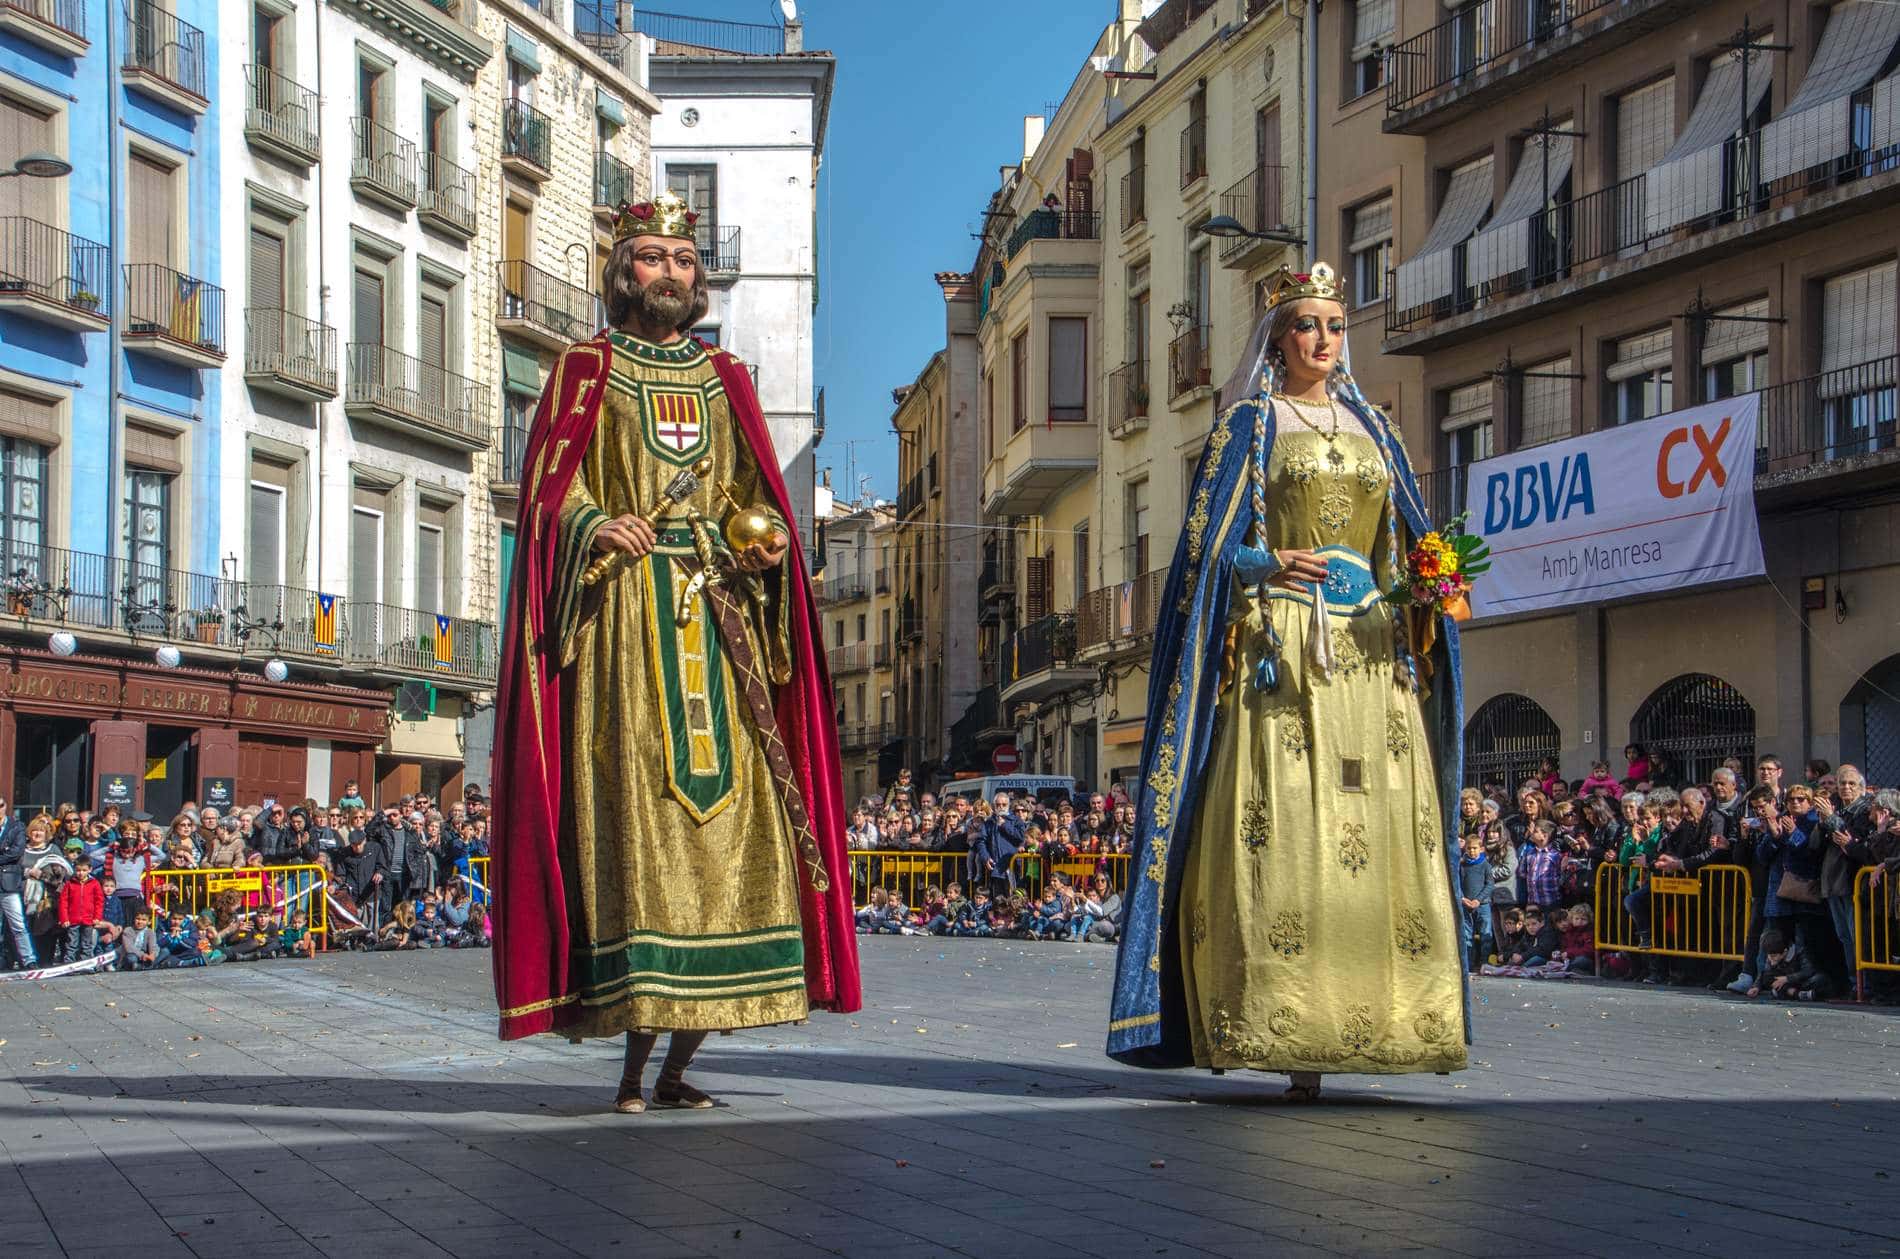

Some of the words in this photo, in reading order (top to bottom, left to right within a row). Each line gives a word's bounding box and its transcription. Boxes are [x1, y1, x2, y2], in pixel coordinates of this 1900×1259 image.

[1484, 452, 1595, 536] BBVA
[1657, 417, 1731, 499] CX
[1542, 551, 1578, 580] Amb
[1584, 542, 1662, 576] Manresa
[140, 687, 209, 712] FERRER
